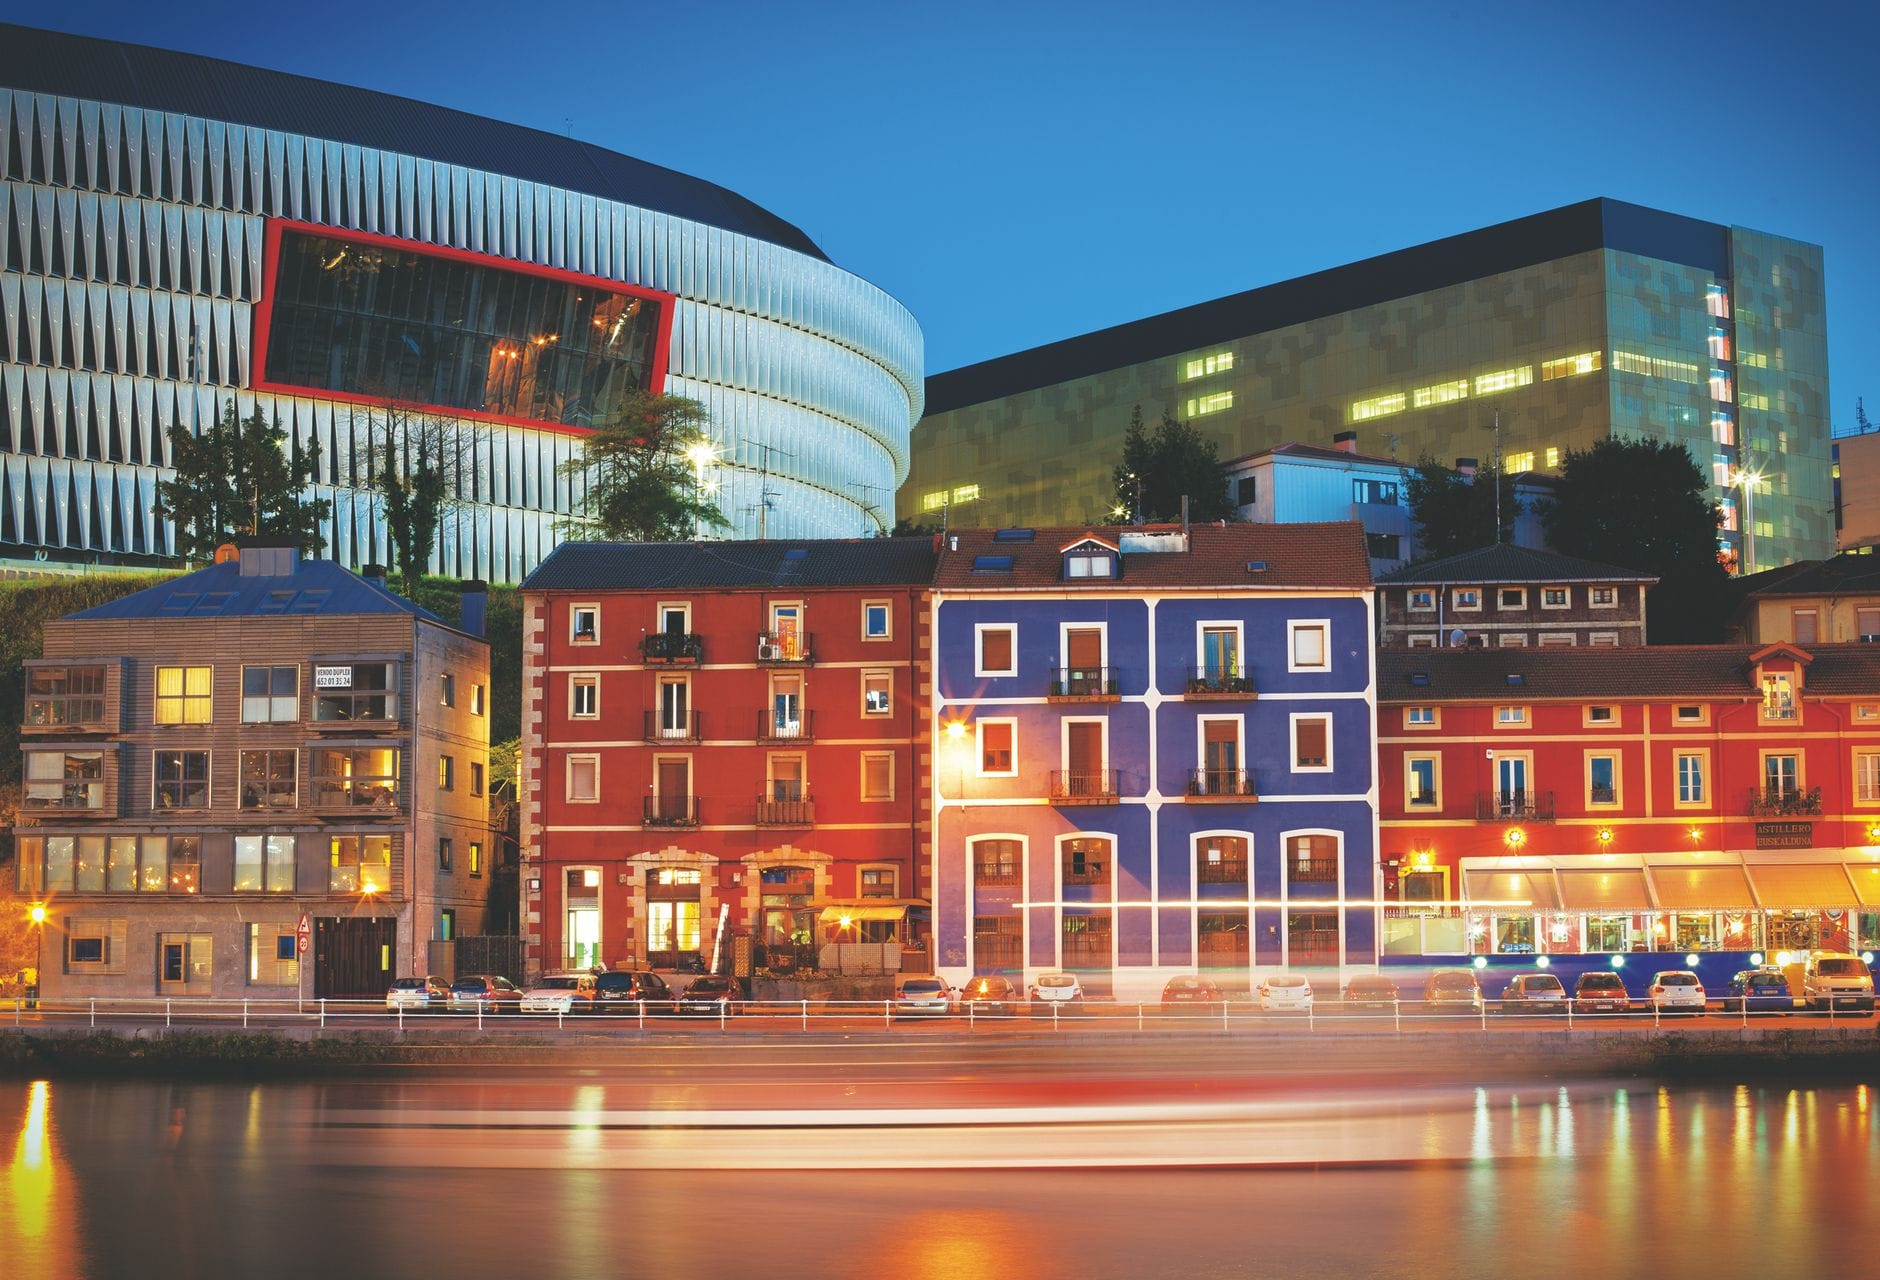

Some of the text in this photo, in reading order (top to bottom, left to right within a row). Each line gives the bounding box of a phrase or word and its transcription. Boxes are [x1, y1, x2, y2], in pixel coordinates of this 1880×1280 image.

[35, 550, 48, 561] 10
[317, 668, 332, 676] VENDO
[317, 677, 327, 685] 652
[336, 677, 342, 685] 35
[343, 677, 350, 685] 24
[1757, 824, 1812, 834] ASTILLERO
[1757, 837, 1812, 847] EUSKALDUNA
